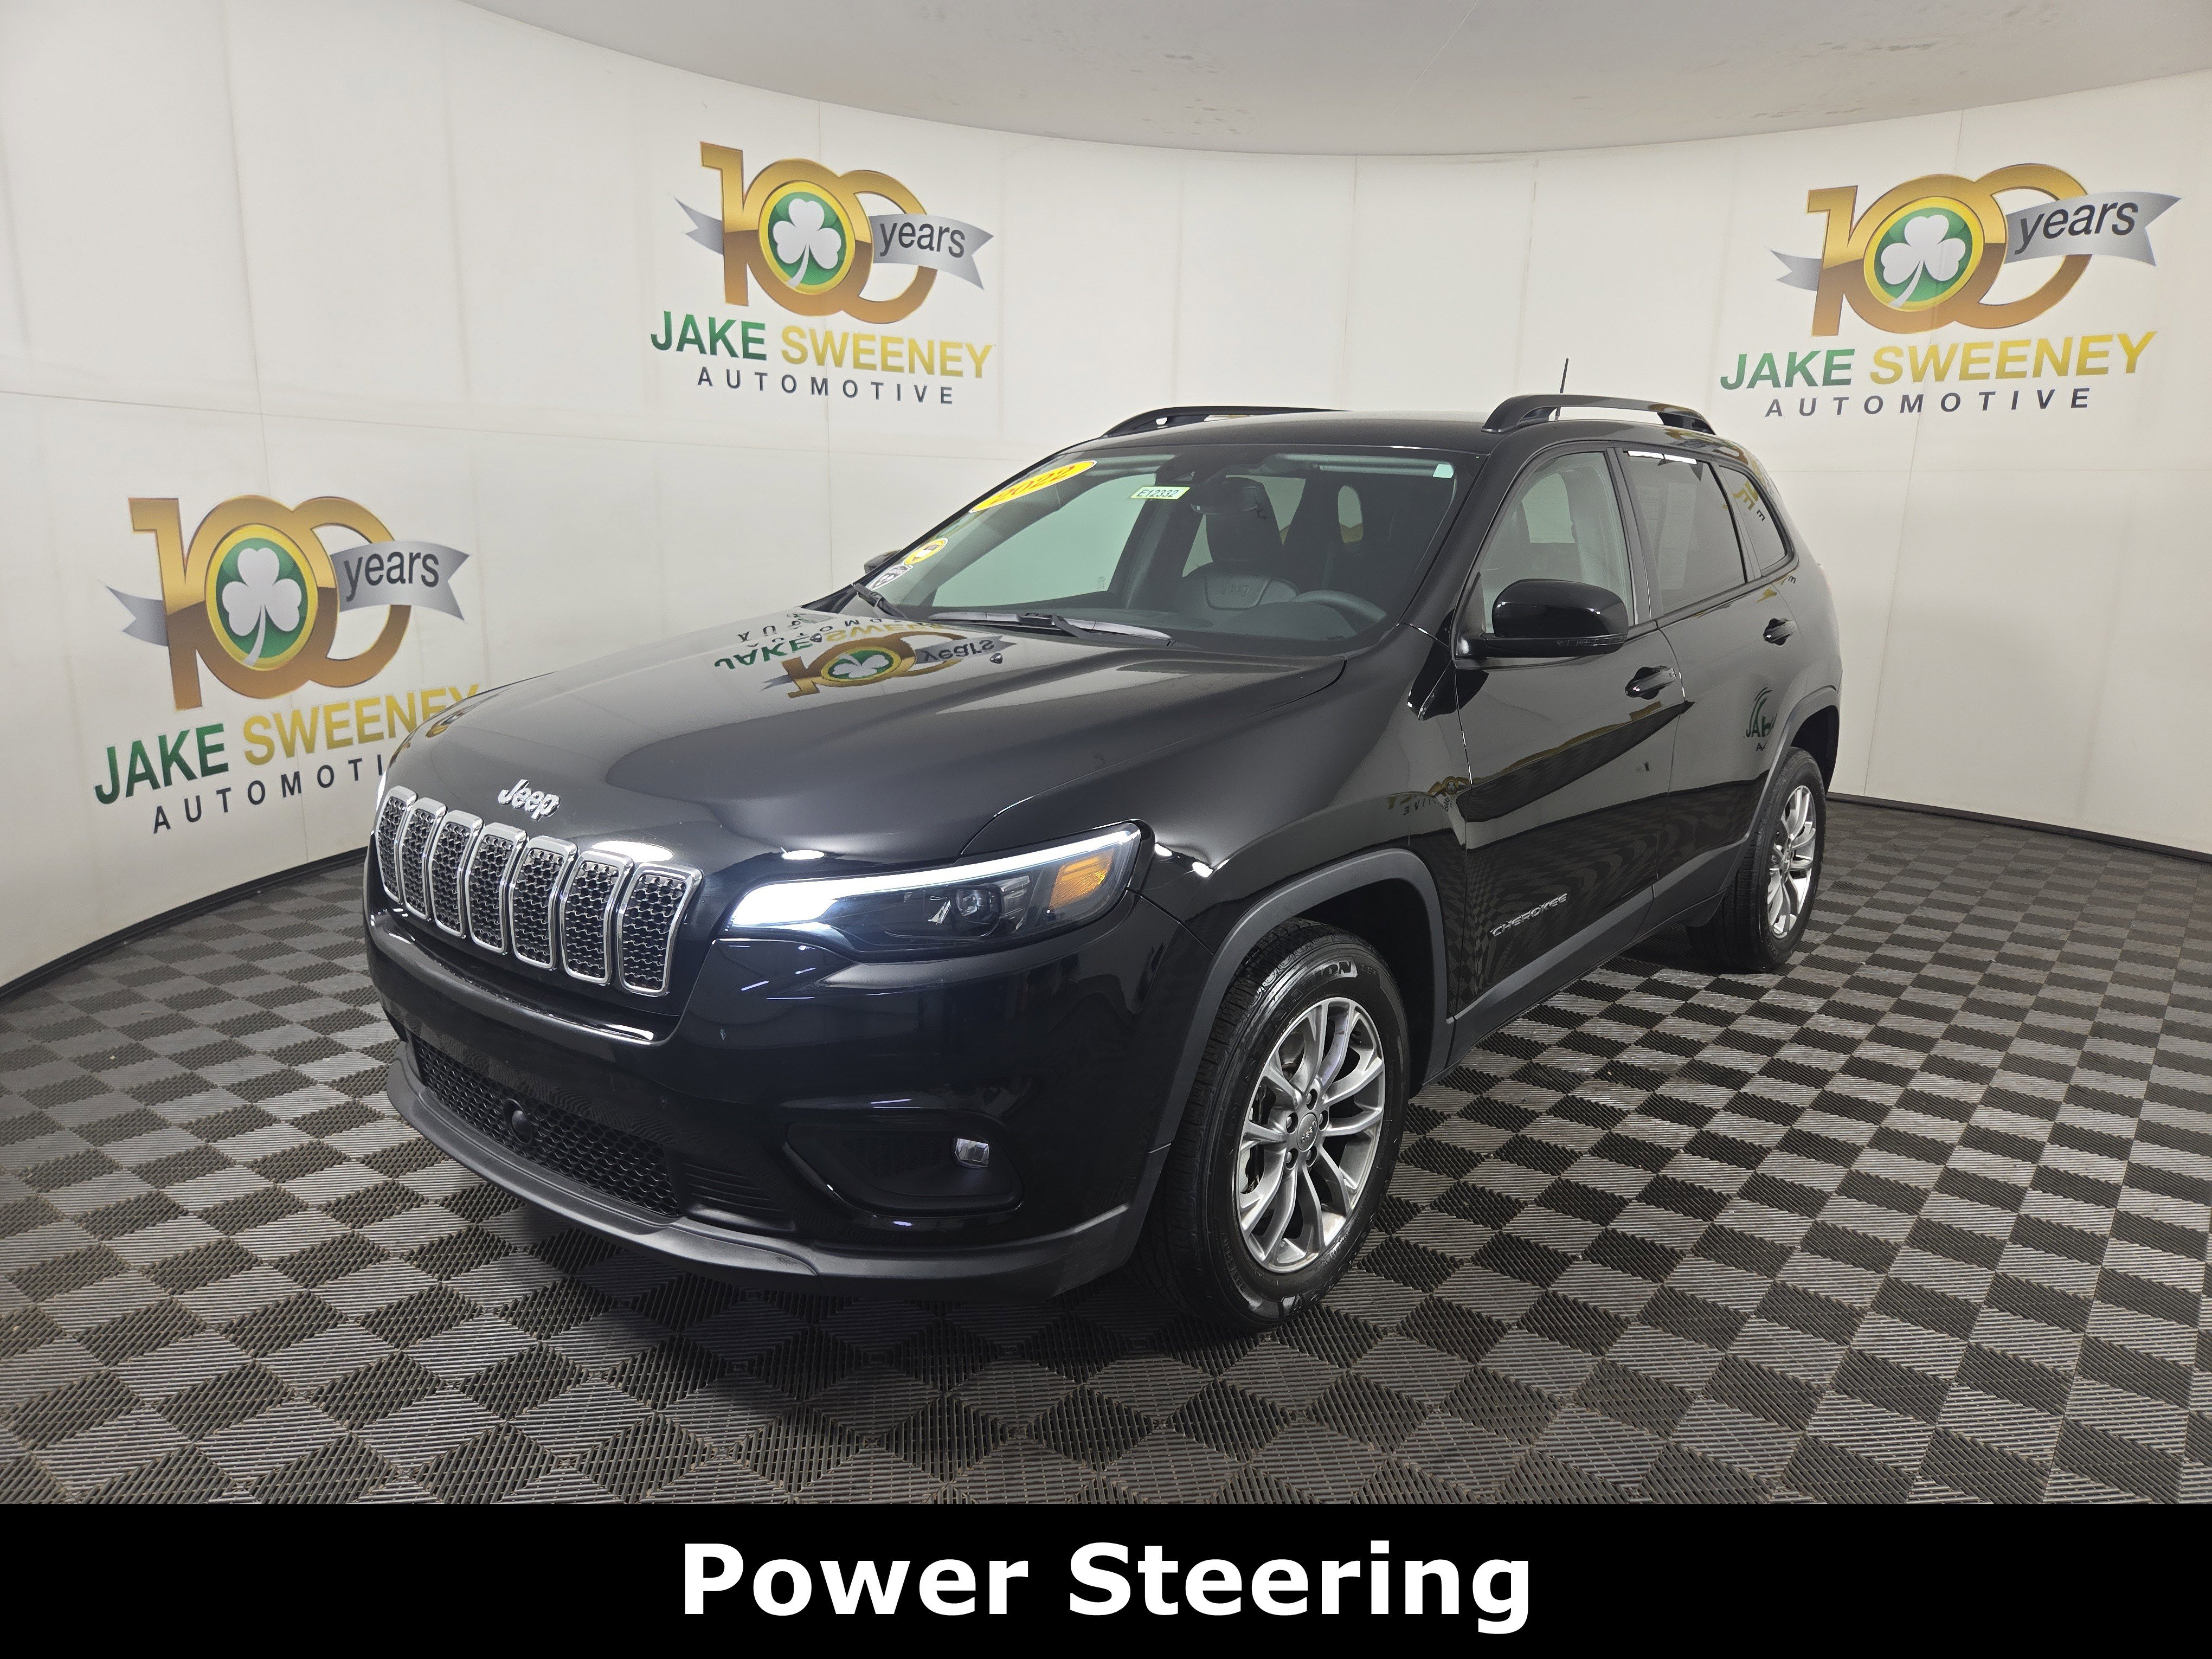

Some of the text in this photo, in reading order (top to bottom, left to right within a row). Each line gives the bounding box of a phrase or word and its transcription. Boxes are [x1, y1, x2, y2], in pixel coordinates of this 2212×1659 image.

[879, 221, 966, 258] years
[2015, 201, 2139, 256] years
[651, 310, 993, 379] JAKE SWEENEY
[1720, 331, 2157, 391] JAKE SWEENEY
[697, 366, 953, 404] AUTOMOTIVE
[1765, 388, 2091, 419] AUTOMOTIVE
[988, 465, 1076, 505] 2022
[1136, 489, 1179, 497] E12332
[343, 551, 440, 602] years
[94, 723, 229, 805] JAKE
[153, 754, 384, 834] AUTOMOTI
[498, 779, 561, 821] Jeep
[1490, 893, 1568, 937] CHEROKEE
